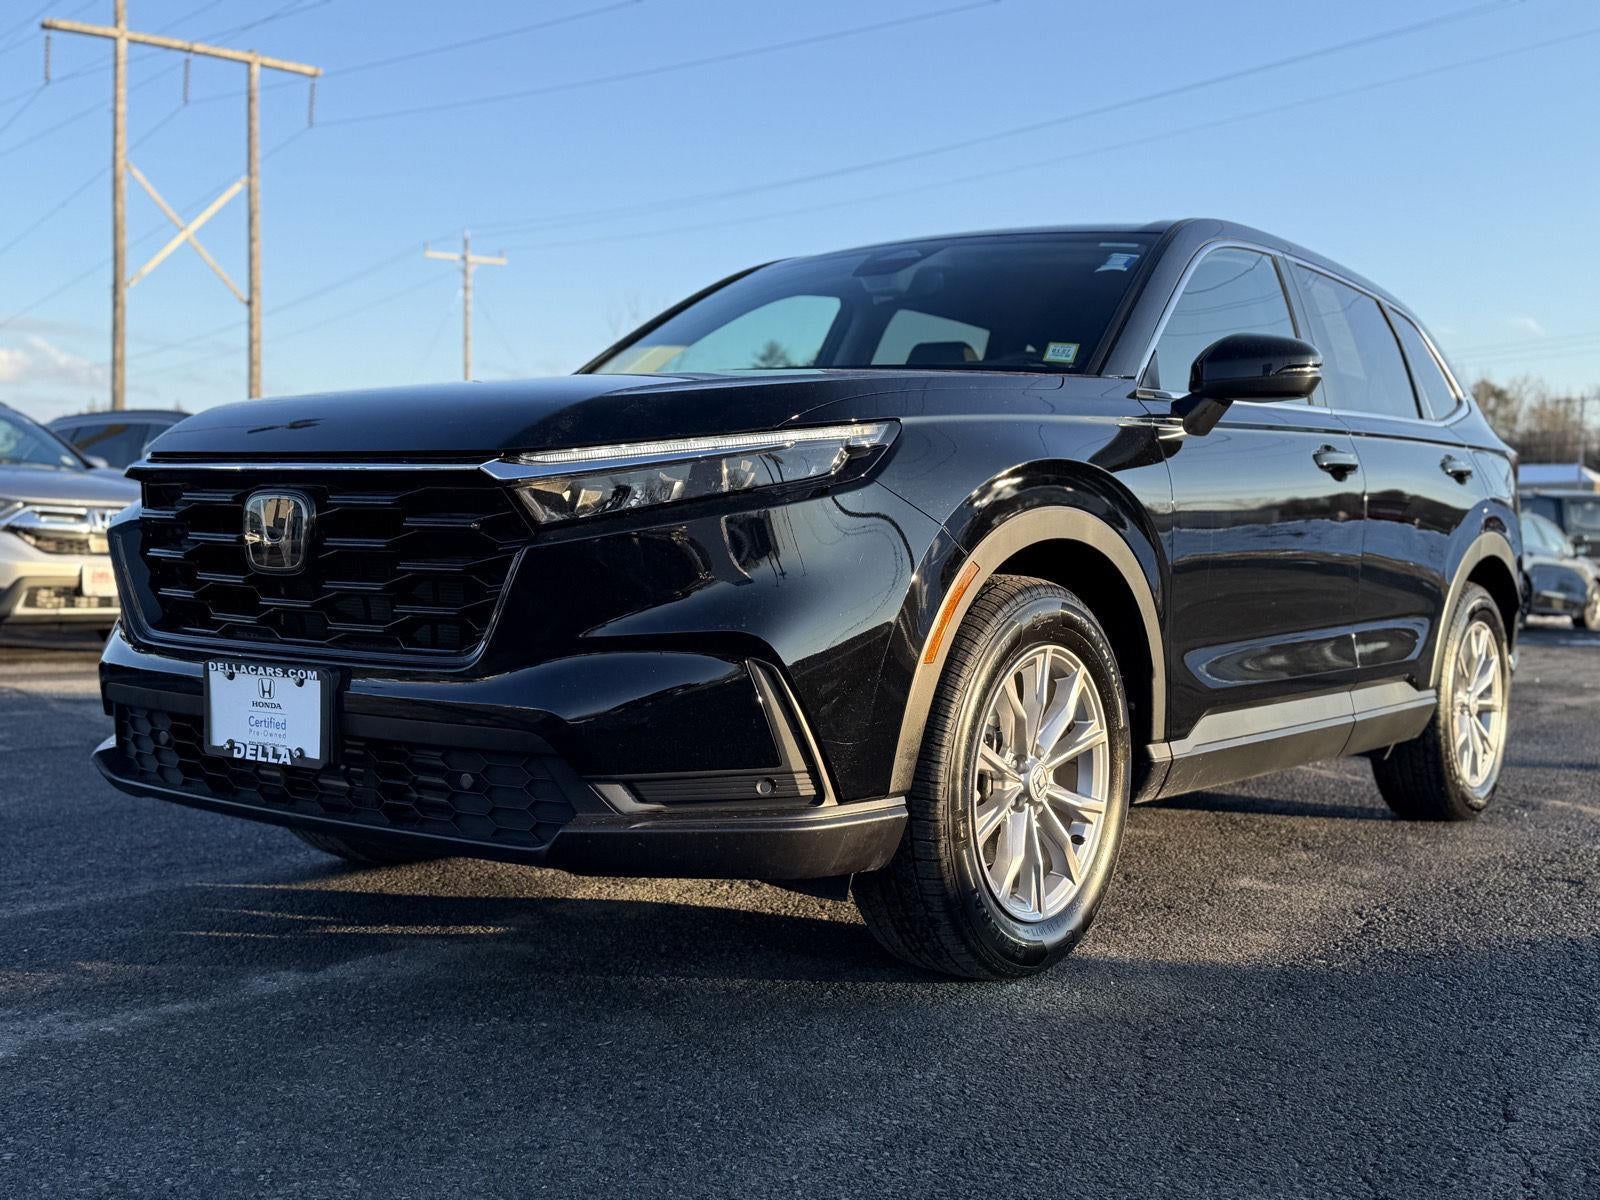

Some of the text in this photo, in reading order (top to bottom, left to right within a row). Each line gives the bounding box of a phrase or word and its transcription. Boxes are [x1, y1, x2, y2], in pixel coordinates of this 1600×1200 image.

[208, 661, 318, 681] DELLACARS.COM
[252, 700, 282, 710] HONDA
[248, 715, 287, 731] Certified
[233, 743, 292, 765] DELLA
